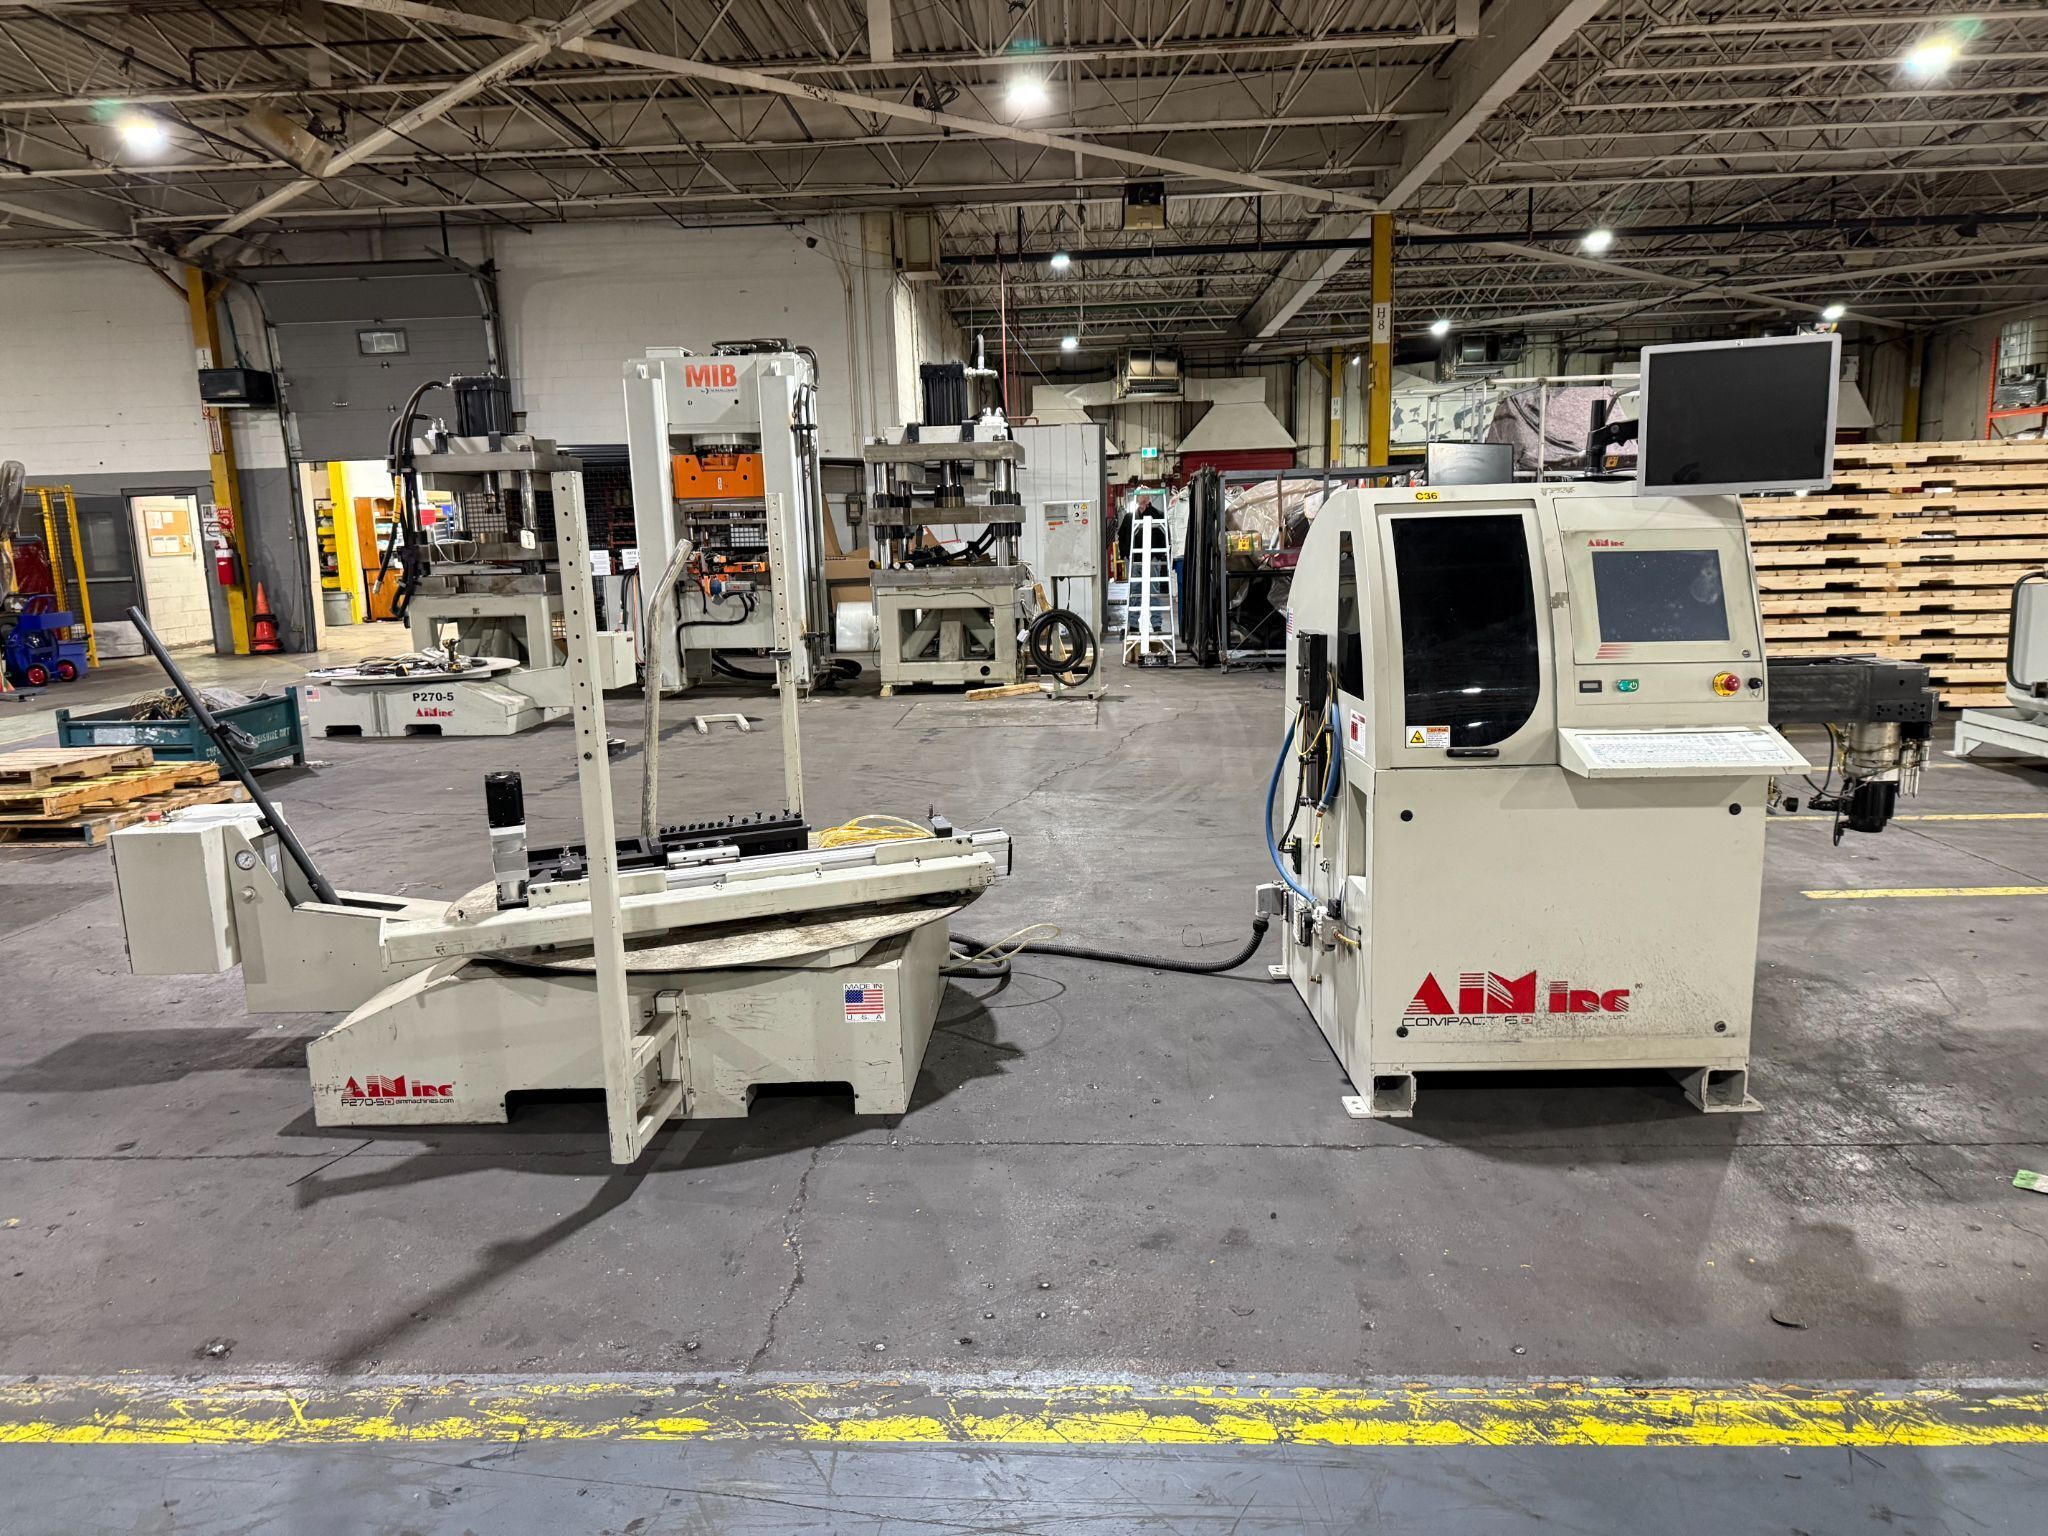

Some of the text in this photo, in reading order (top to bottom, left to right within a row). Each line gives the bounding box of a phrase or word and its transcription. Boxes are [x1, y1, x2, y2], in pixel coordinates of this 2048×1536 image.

[685, 364, 737, 388] MIB
[1415, 492, 1438, 501] C36
[412, 692, 454, 702] P270-5
